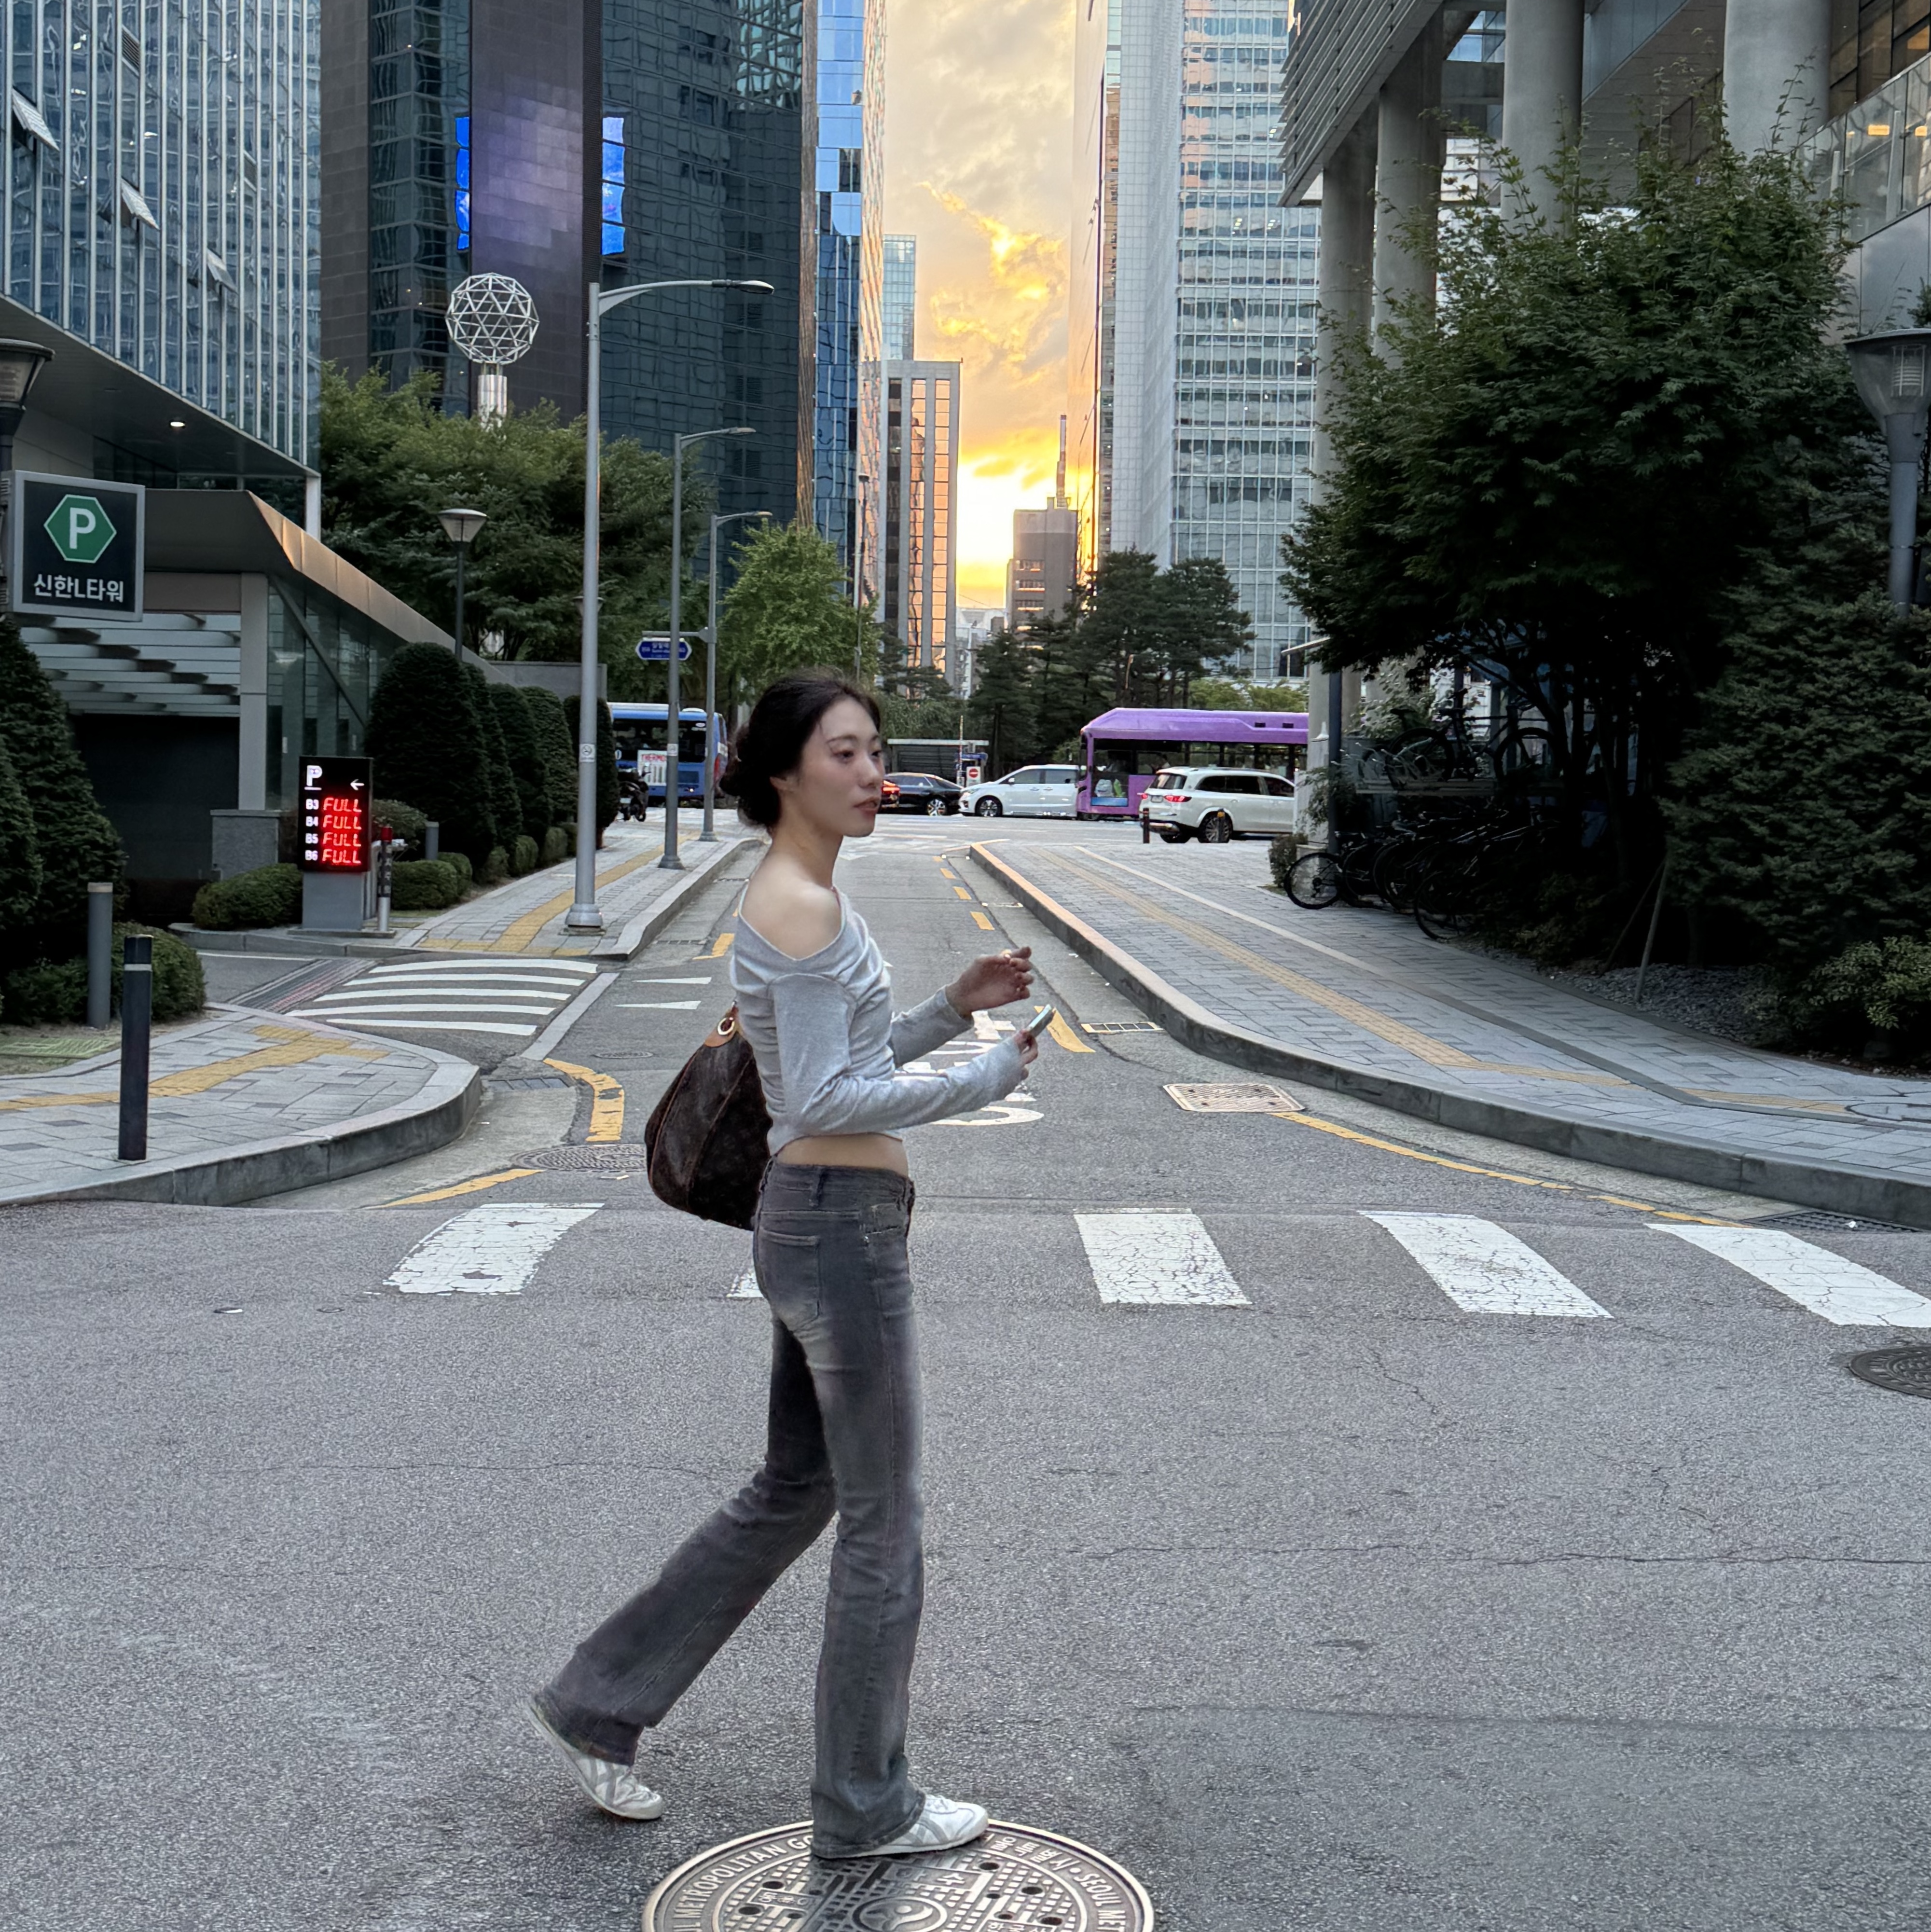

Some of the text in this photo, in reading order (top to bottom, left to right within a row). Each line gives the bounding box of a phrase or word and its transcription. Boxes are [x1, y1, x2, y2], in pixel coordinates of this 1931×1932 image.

[69, 507, 96, 549] P
[34, 573, 124, 603] 신한L타워
[306, 765, 322, 787] P
[305, 797, 362, 813] B3 FULL
[305, 814, 362, 830] B4 FULL
[305, 832, 361, 847] B5 FULL
[304, 848, 361, 864] B6 FULL
[673, 1844, 787, 1919] METROPOLITAN
[1074, 1873, 1122, 1907] SEOUL
